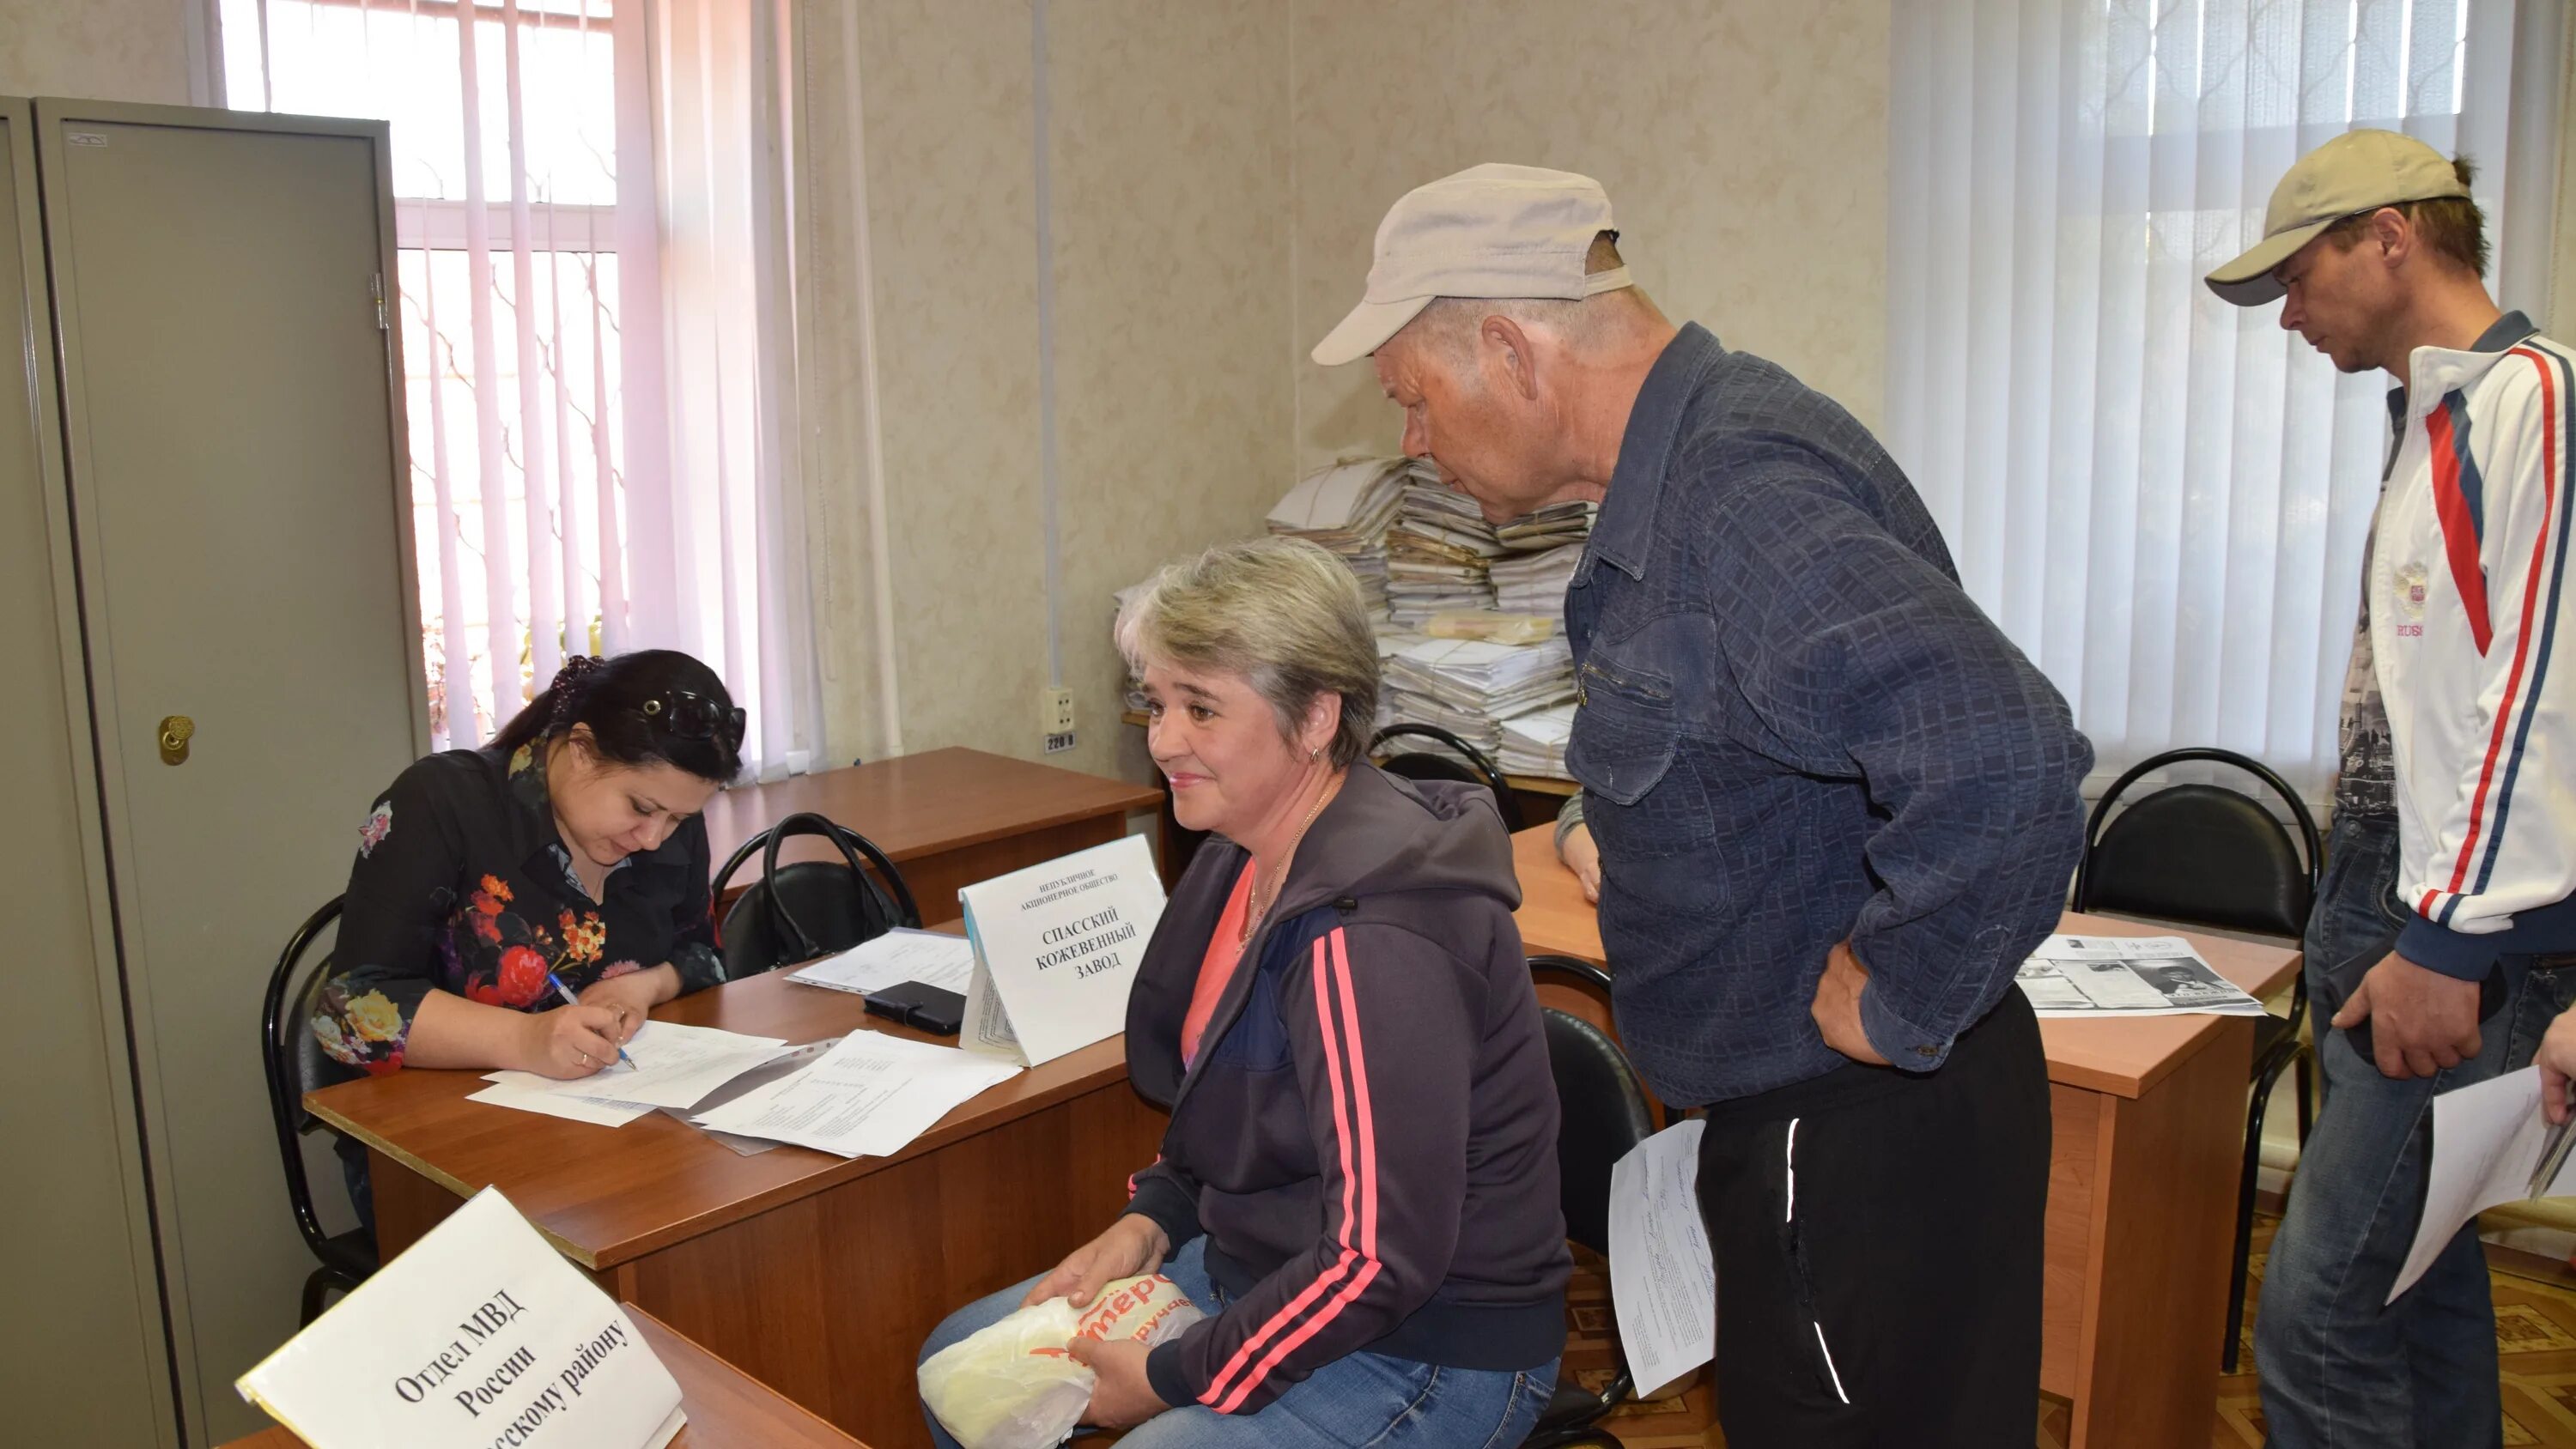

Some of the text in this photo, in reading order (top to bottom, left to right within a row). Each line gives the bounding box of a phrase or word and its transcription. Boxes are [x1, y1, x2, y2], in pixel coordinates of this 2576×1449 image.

[1021, 874, 1118, 911] АКЦИОНЕРНОЕ ОБЩЕСТВО
[1039, 869, 1095, 893] НЕПУБЛИЧНОЕ
[1036, 922, 1136, 970] КОЖЕВЕННЫЙ
[1042, 906, 1119, 945] СПАССКИЙ
[1074, 953, 1121, 979] ЗАВОД
[395, 1289, 528, 1404] Отдел МВД
[453, 1345, 537, 1418] России
[488, 1319, 629, 1449] сскому району
